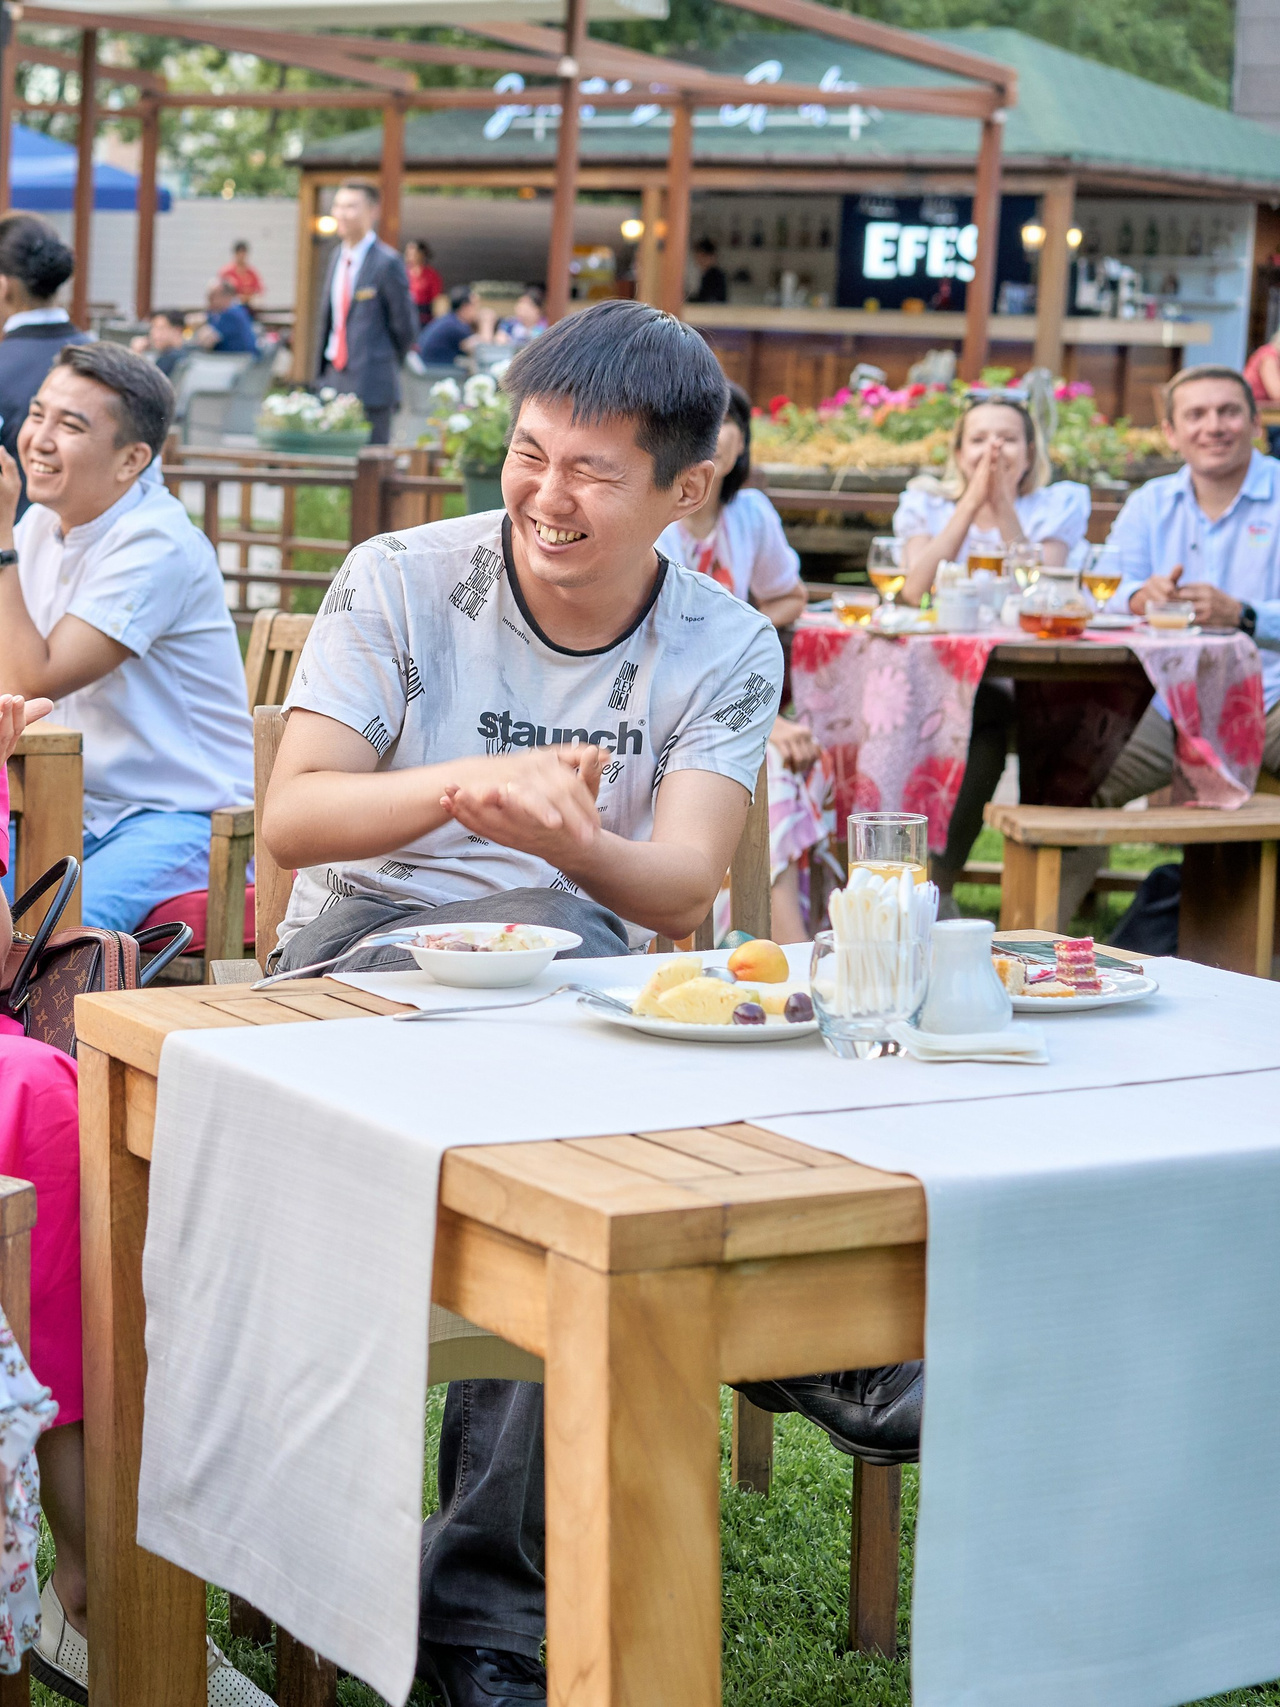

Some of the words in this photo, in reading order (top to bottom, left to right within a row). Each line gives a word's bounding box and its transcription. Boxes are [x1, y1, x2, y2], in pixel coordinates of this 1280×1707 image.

[863, 222, 978, 282] EFES
[470, 545, 495, 572] THERE
[465, 567, 495, 597] ENOUGH
[448, 582, 471, 609] FREE
[460, 591, 488, 621] SPACE
[502, 616, 530, 645] innovative
[685, 615, 705, 623] space
[613, 677, 634, 693] PLEX
[619, 660, 639, 682] COM
[608, 689, 629, 711] IDEA
[477, 710, 643, 755] staunch
